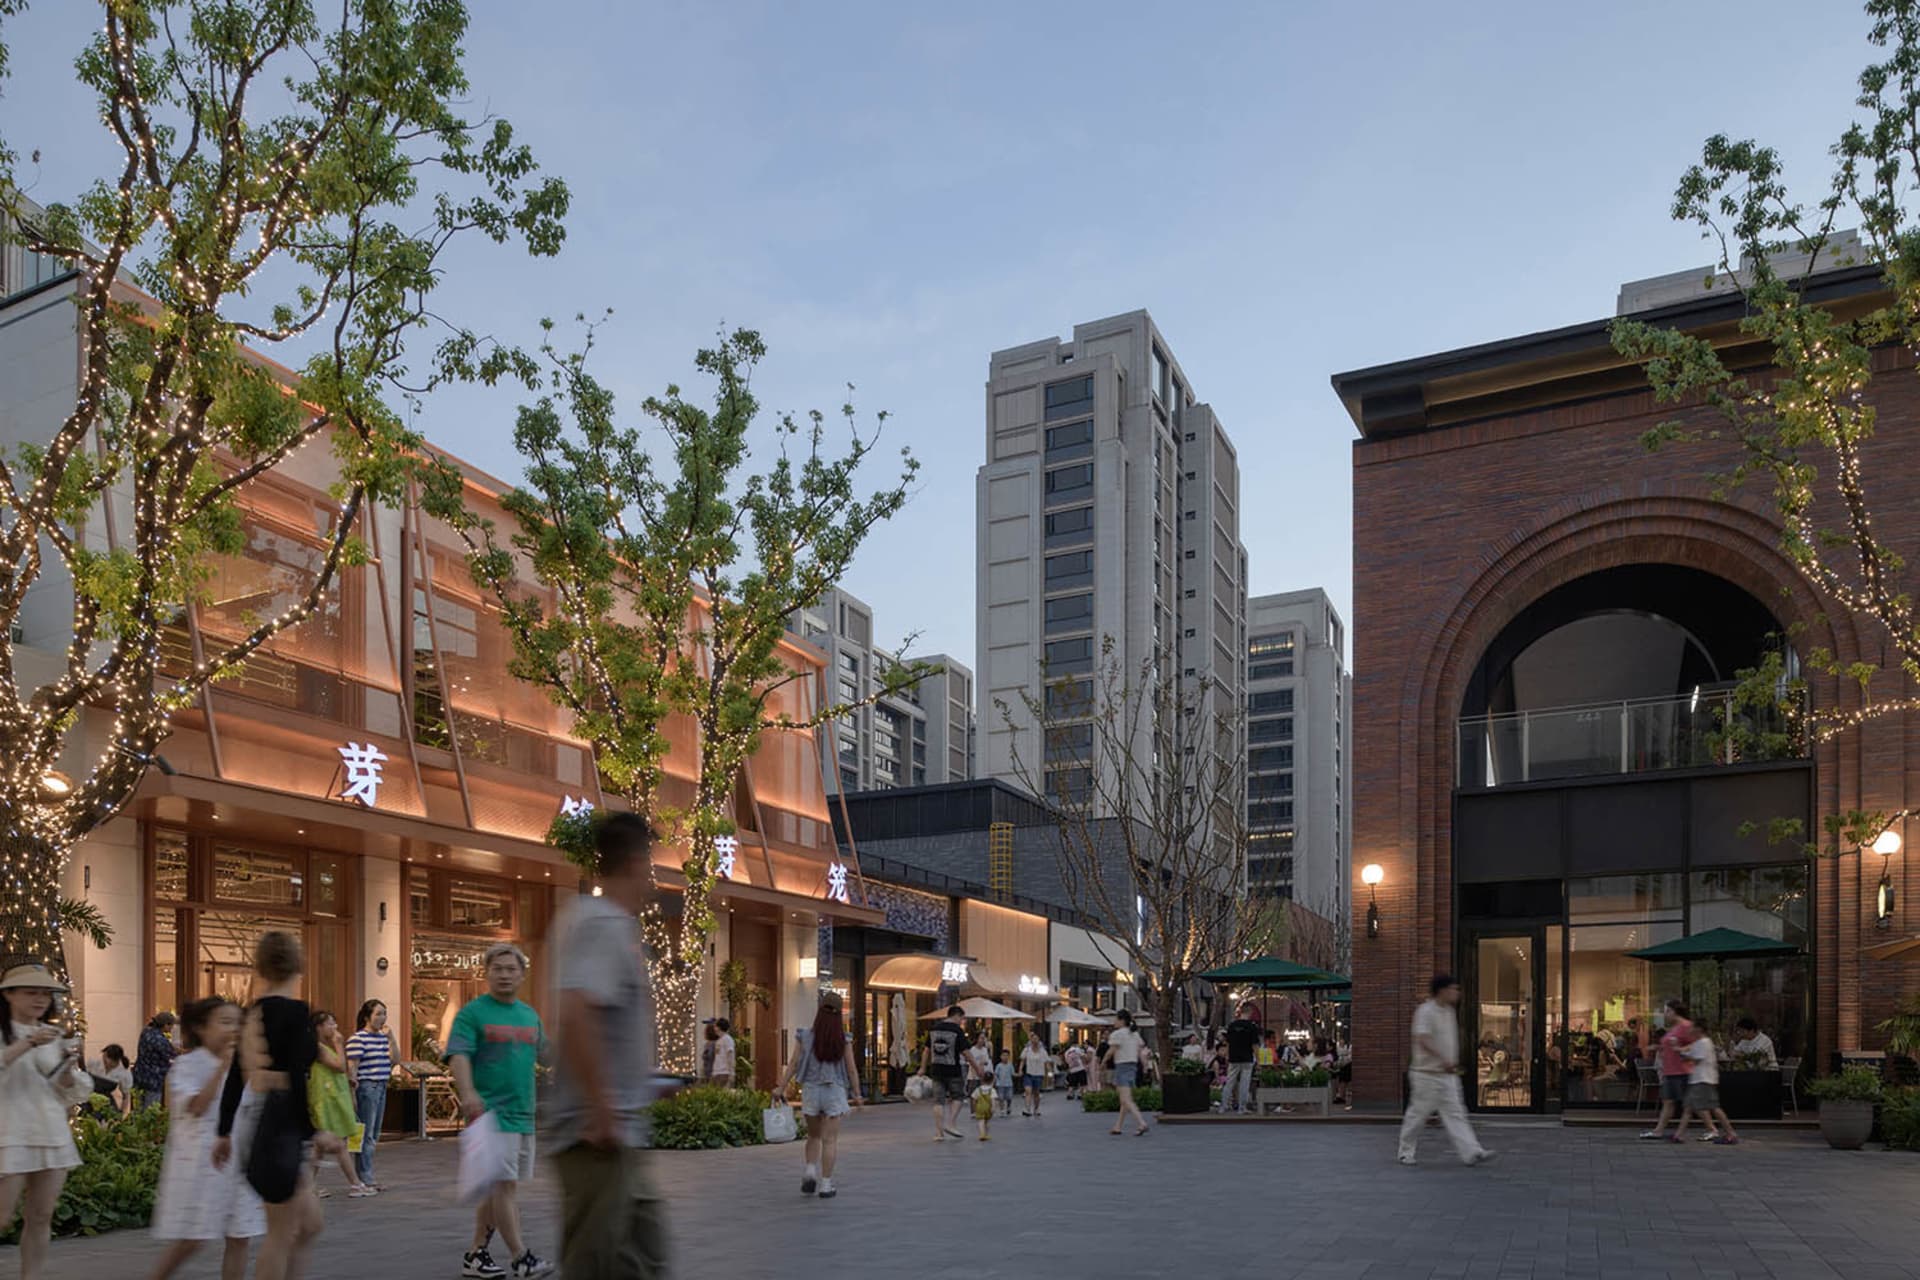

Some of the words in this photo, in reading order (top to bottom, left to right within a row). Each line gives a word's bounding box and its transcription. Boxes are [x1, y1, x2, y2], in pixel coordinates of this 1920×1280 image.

[337, 742, 389, 807] 芽
[713, 834, 738, 879] 芽
[828, 861, 848, 901] 笼
